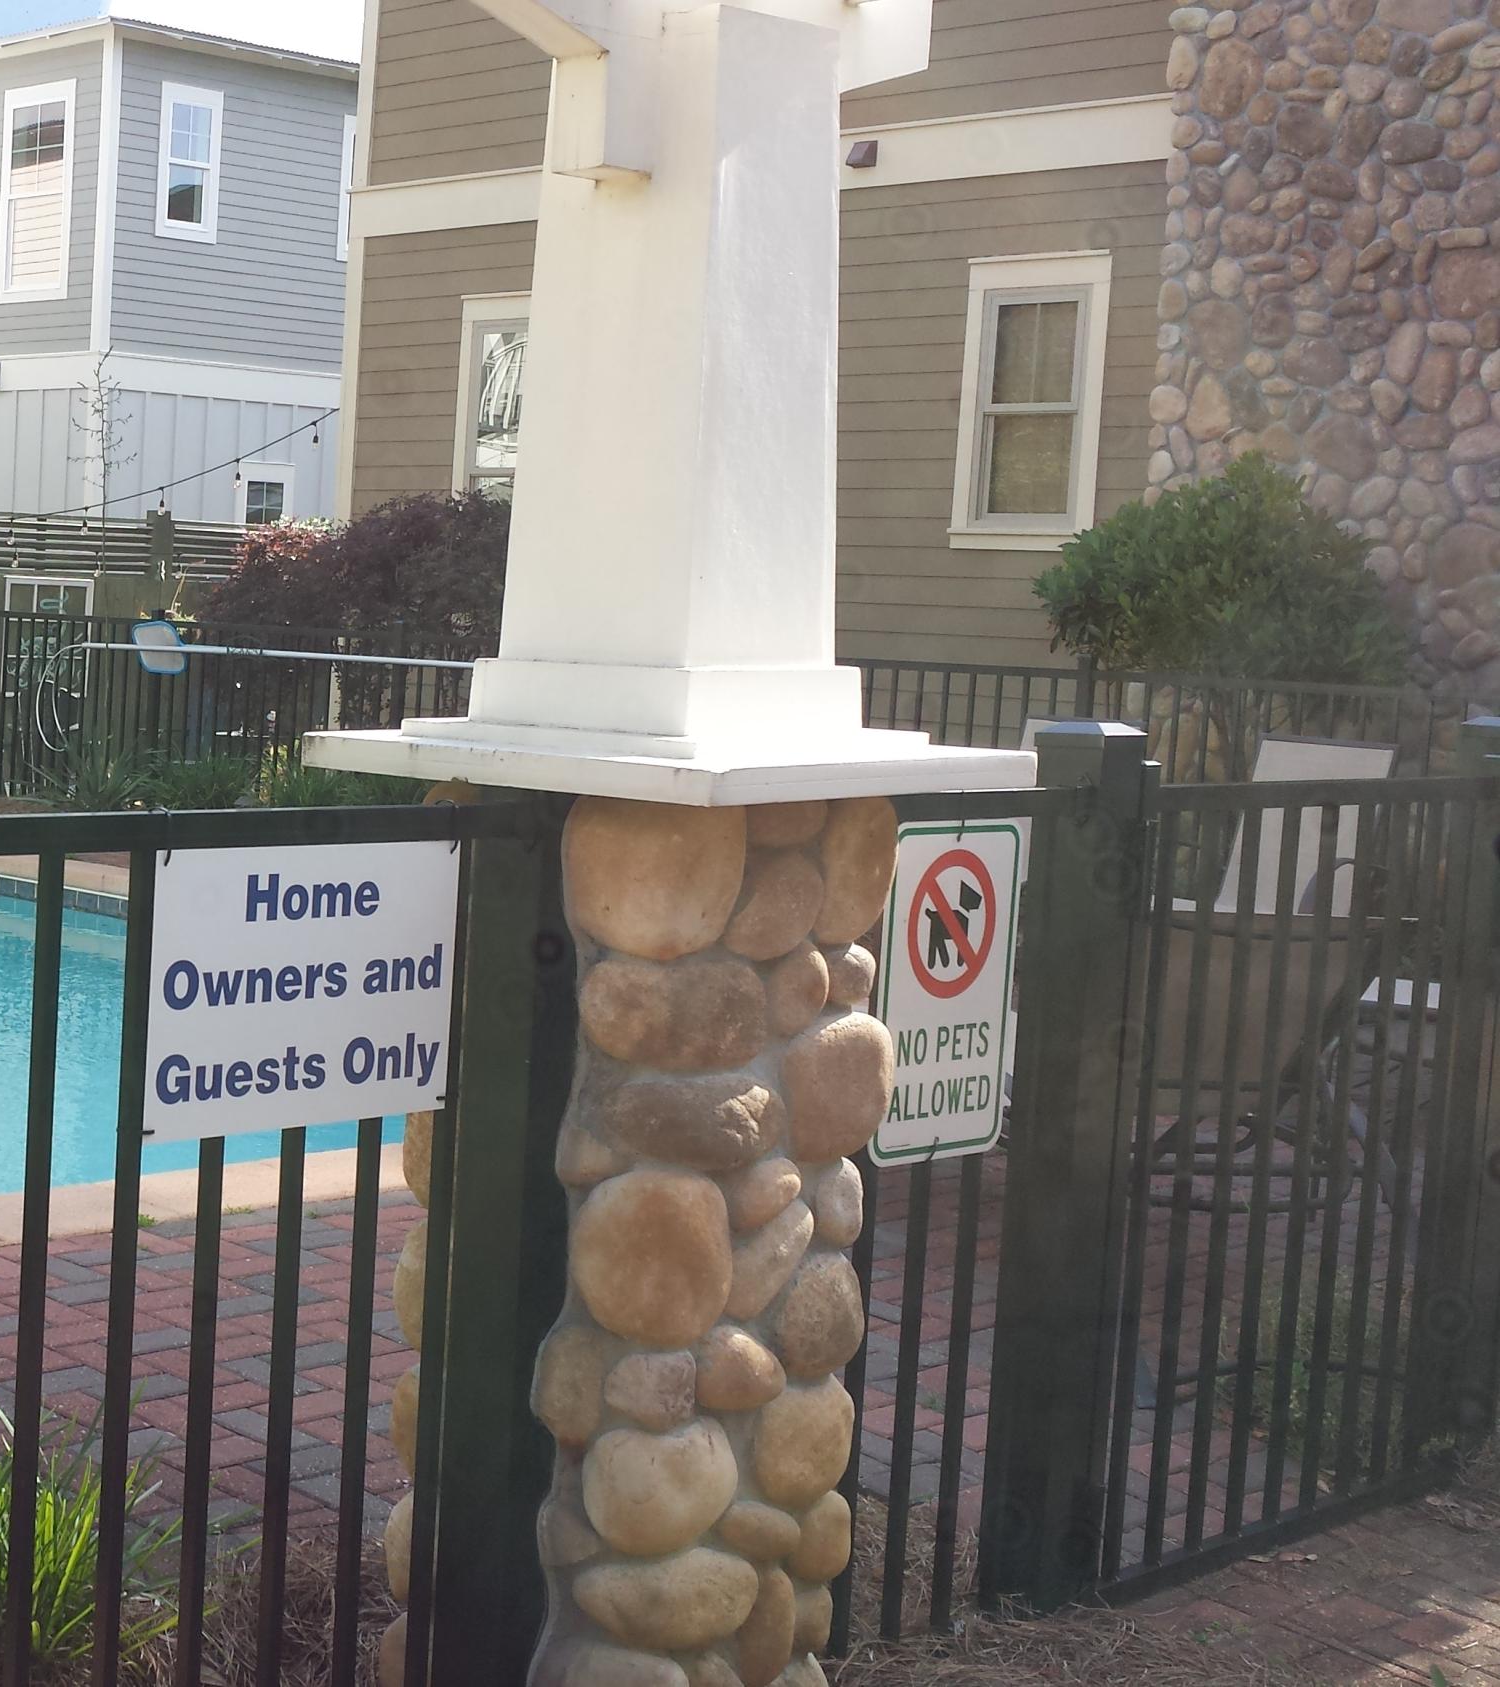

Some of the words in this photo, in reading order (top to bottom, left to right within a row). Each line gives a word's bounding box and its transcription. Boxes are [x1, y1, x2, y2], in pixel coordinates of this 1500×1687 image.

[245, 873, 380, 922] Home
[163, 959, 347, 1010] Owners
[362, 943, 443, 995] and
[155, 1046, 326, 1105] Guests
[342, 1032, 440, 1087] Only
[896, 1028, 928, 1067] NO
[935, 1021, 990, 1063] PETS
[886, 1074, 991, 1123] ALLOWED
